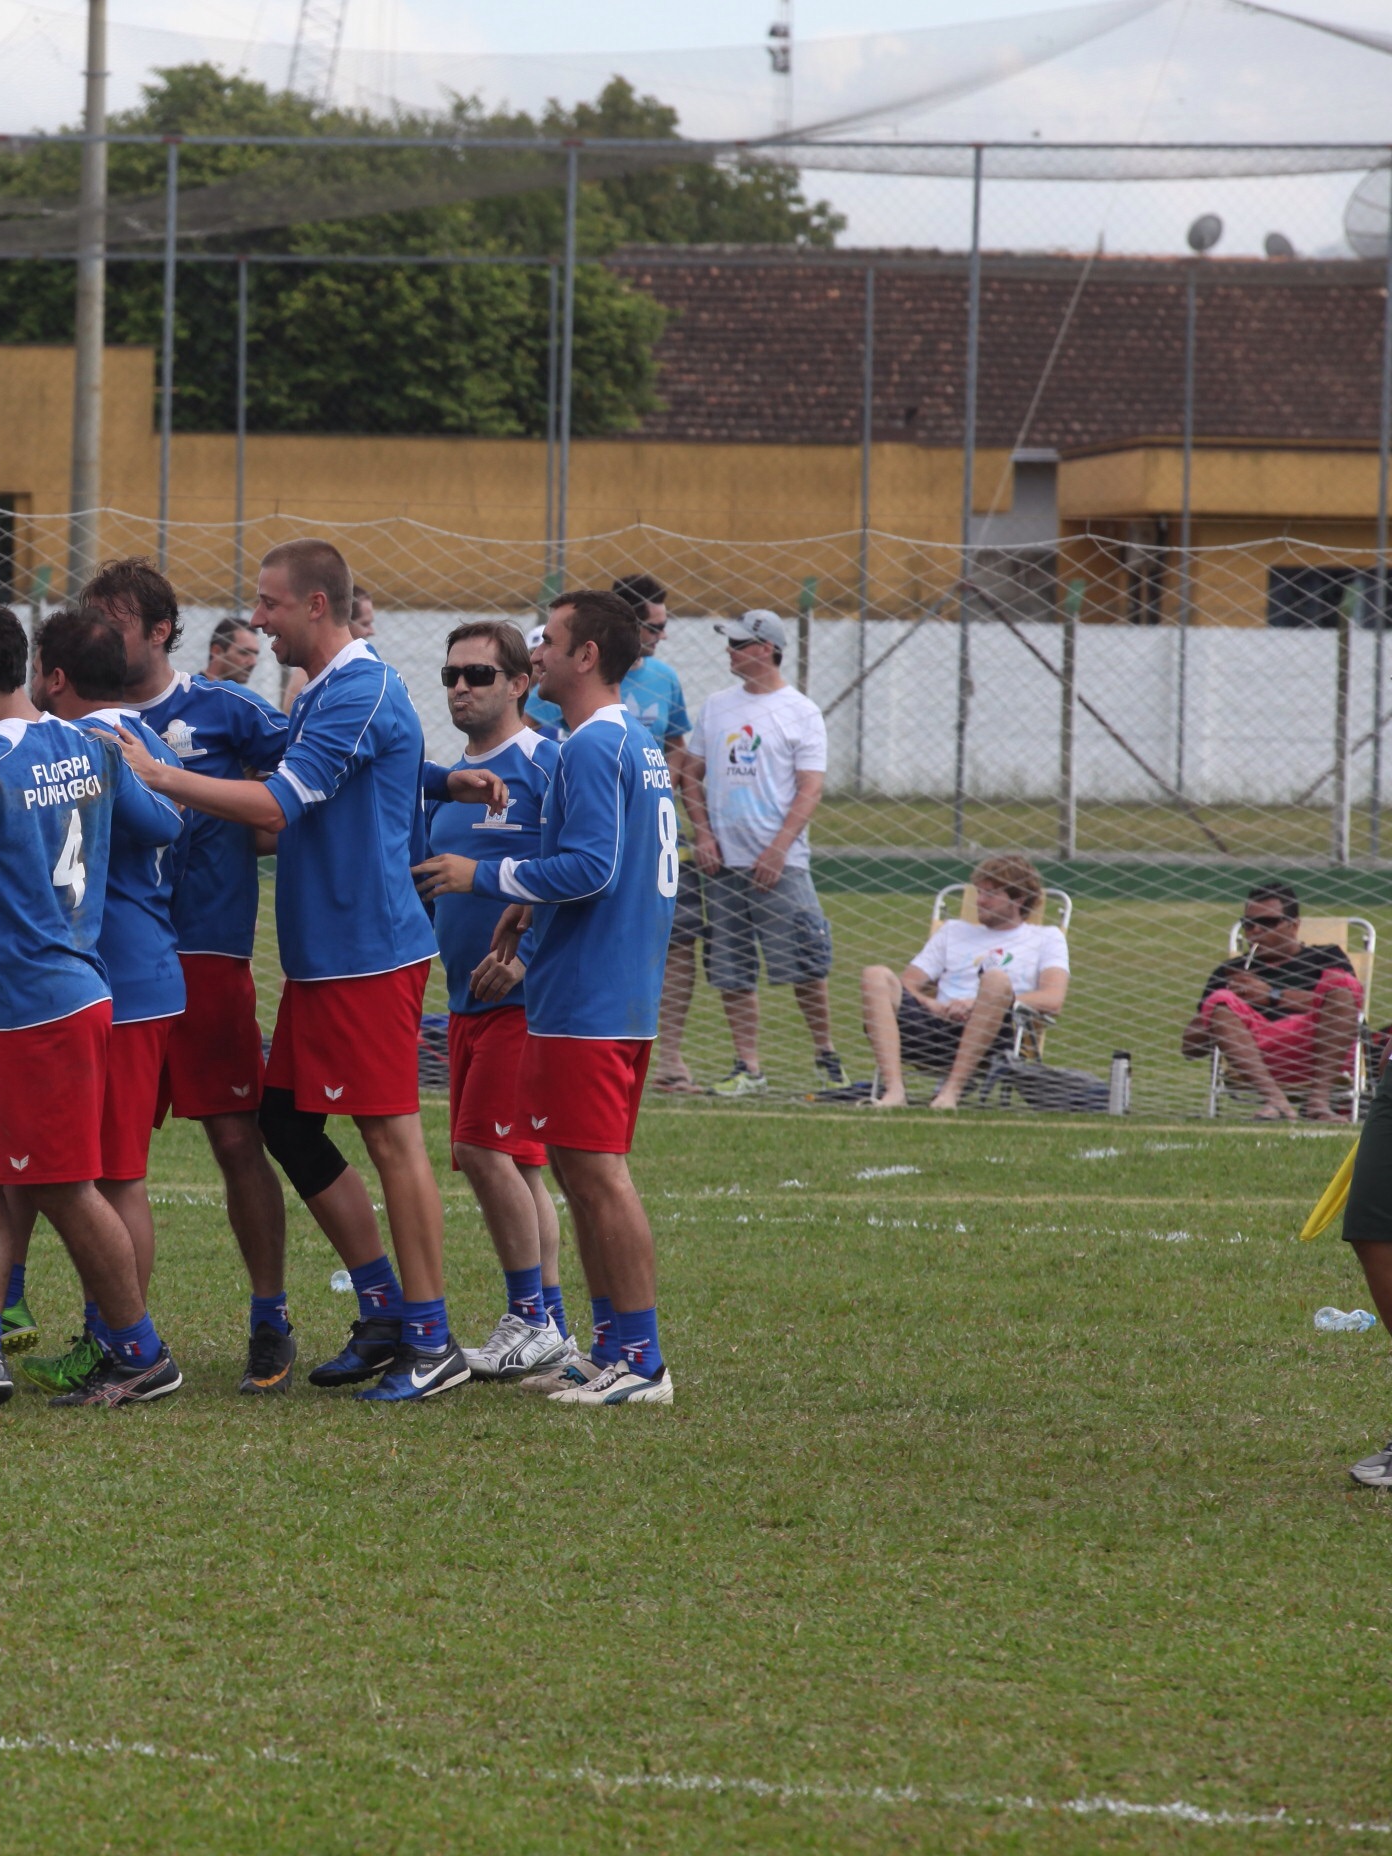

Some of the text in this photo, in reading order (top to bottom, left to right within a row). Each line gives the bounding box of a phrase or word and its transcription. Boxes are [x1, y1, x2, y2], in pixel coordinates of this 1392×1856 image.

[32, 755, 91, 784] FLORPA
[53, 808, 86, 909] 4
[658, 797, 679, 898] 8
